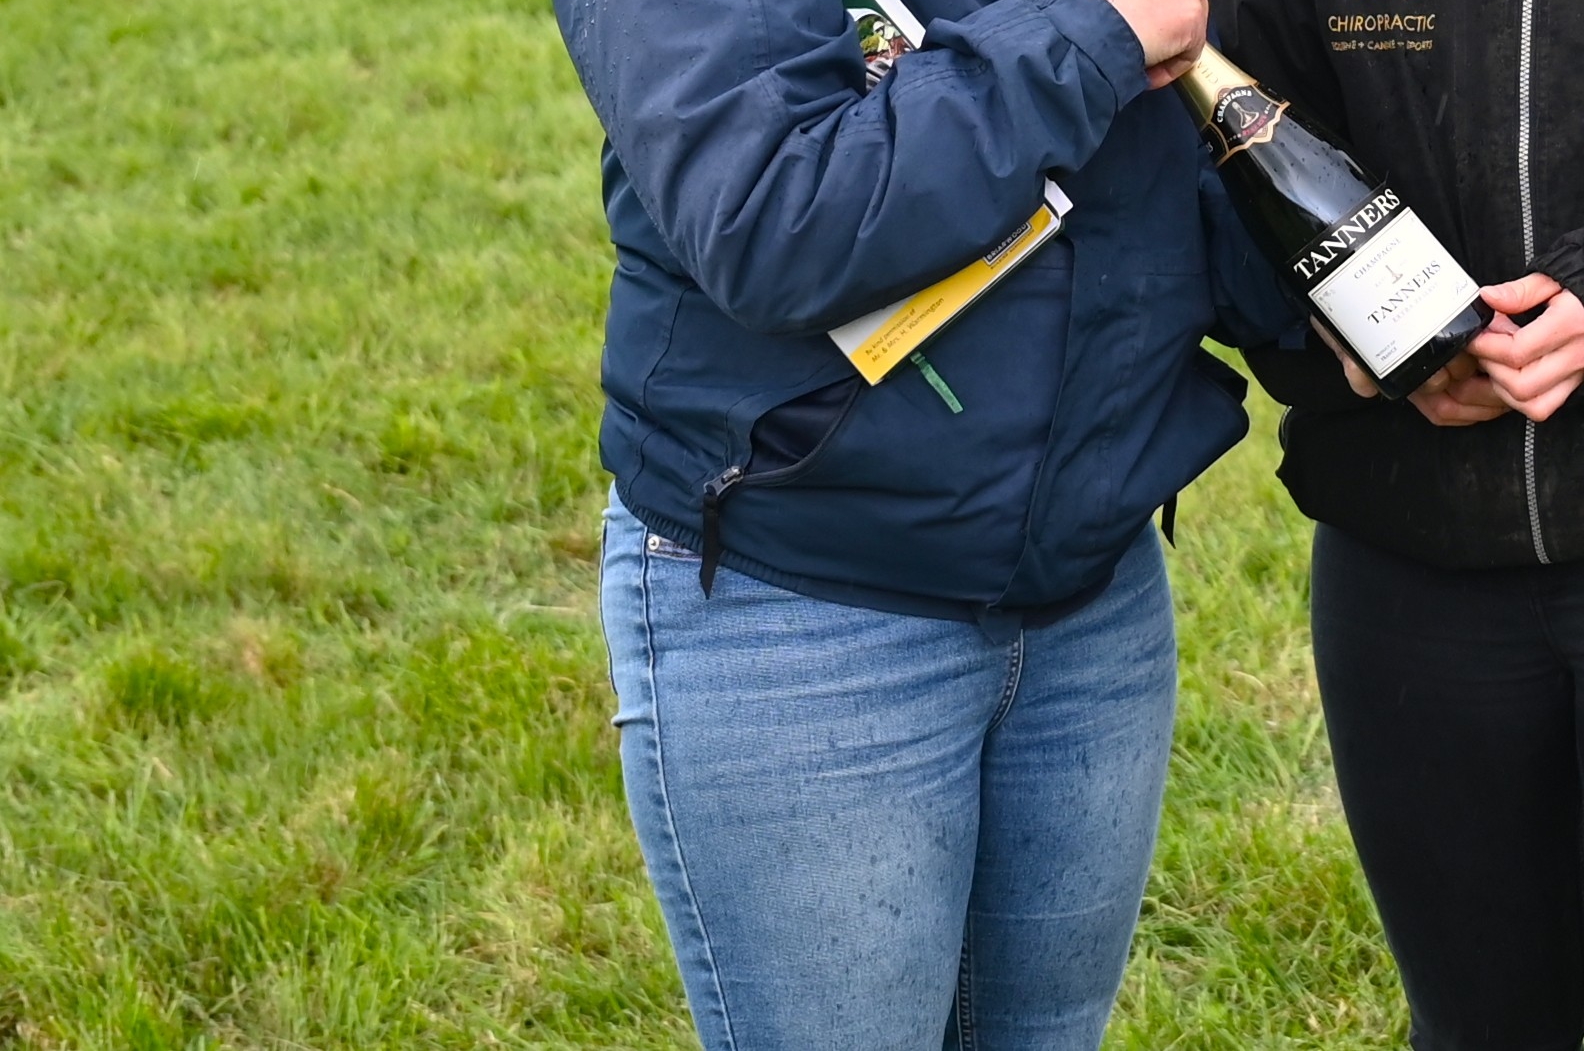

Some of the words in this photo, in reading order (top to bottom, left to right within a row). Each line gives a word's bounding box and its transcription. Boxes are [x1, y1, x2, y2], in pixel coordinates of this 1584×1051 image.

[1328, 14, 1436, 32] CHIROPRACTIC
[1293, 188, 1401, 280] TANNERS
[1367, 260, 1442, 325] TANNERS
